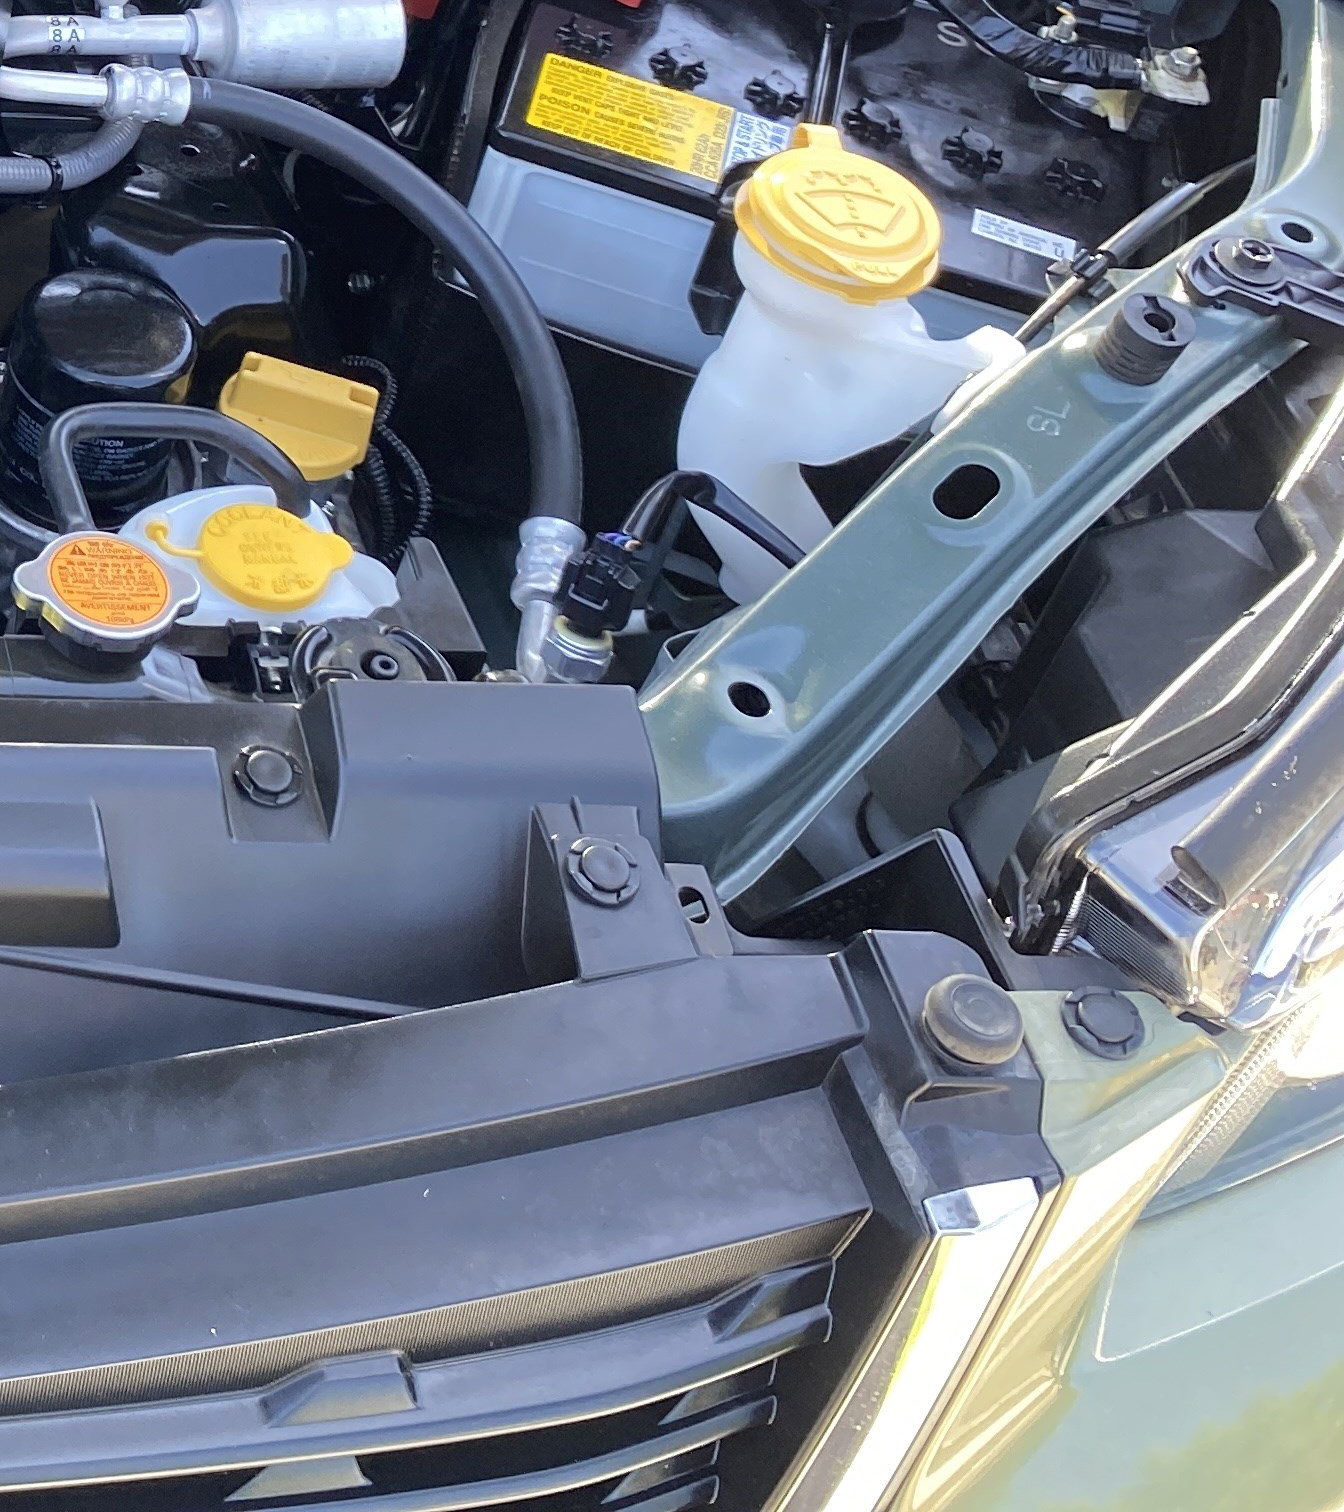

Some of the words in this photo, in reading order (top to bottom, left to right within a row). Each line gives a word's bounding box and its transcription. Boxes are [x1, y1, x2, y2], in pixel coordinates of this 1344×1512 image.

[53, 29, 62, 42] 8
[68, 29, 80, 42] A
[549, 56, 603, 80] DANGER
[538, 93, 591, 115] POISON
[1026, 399, 1072, 438] SL
[207, 507, 311, 537] COOLANT
[85, 546, 132, 555] WARNING
